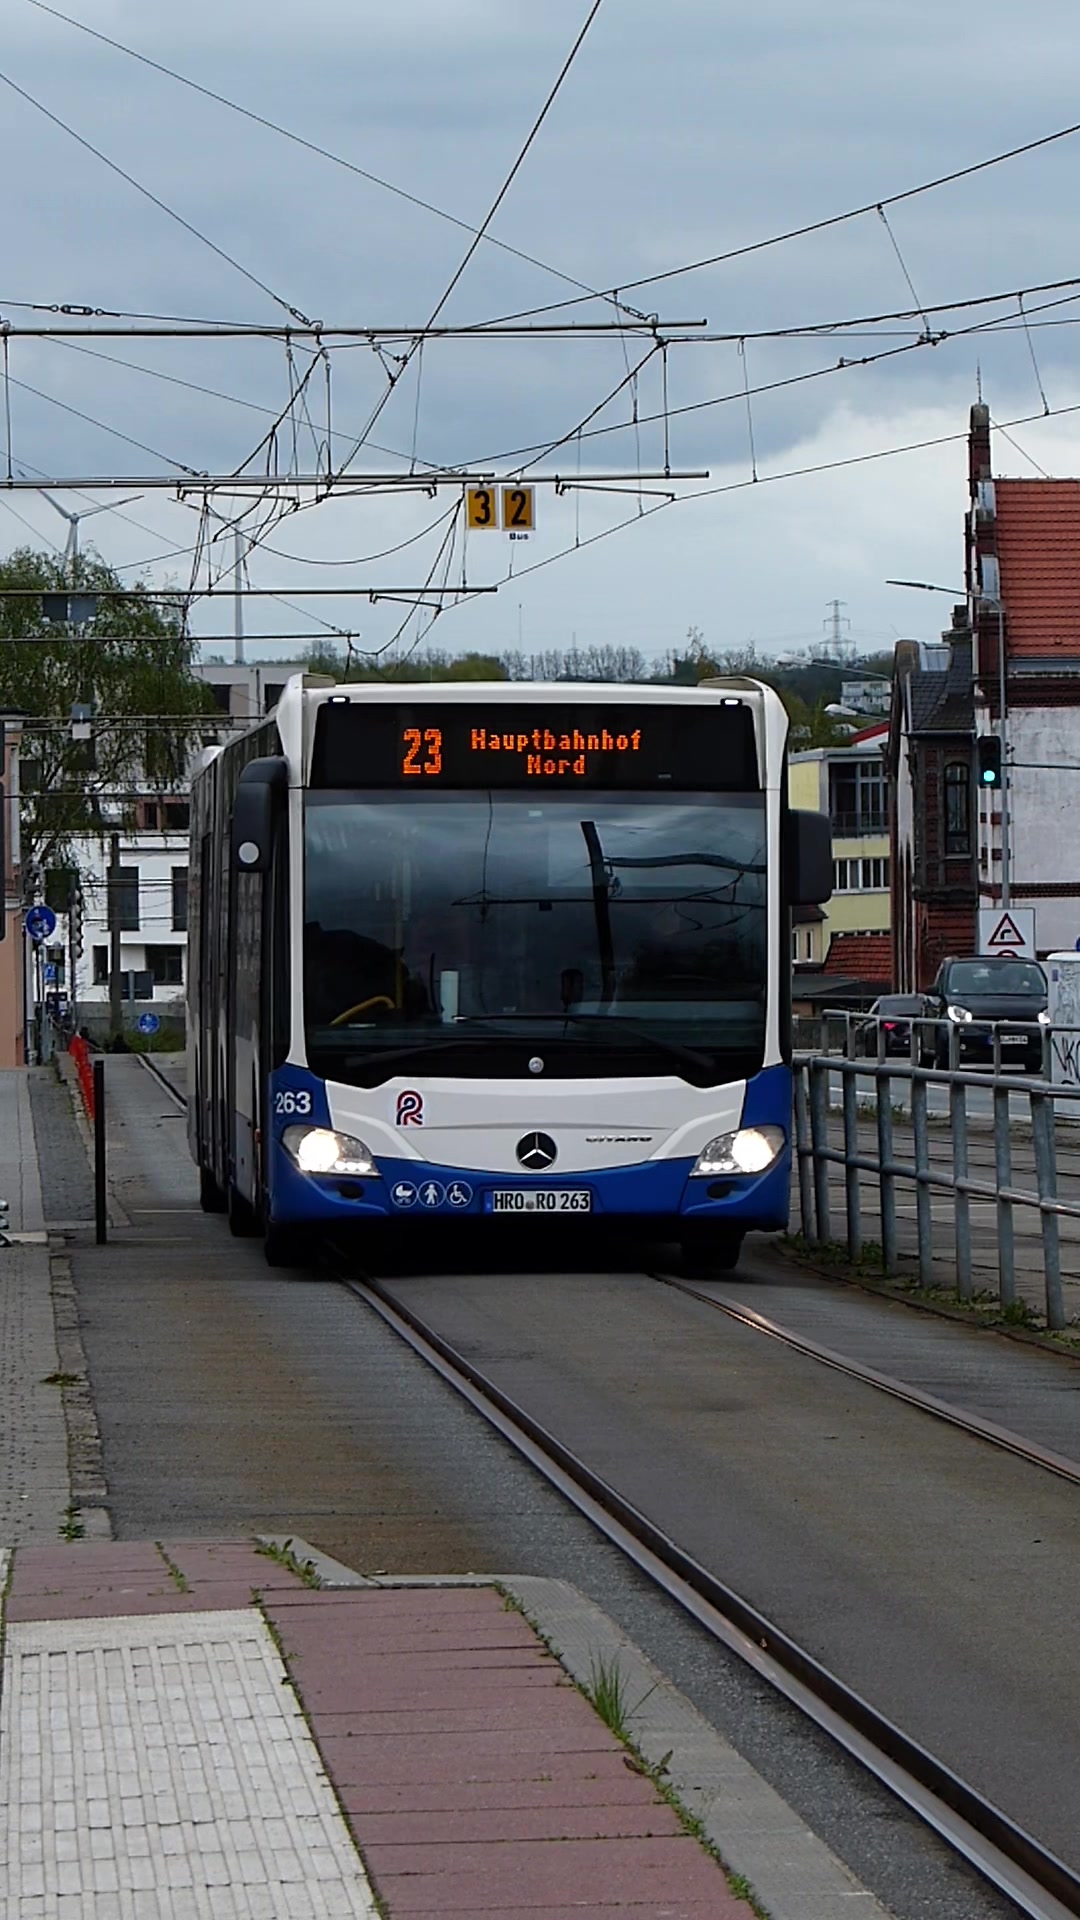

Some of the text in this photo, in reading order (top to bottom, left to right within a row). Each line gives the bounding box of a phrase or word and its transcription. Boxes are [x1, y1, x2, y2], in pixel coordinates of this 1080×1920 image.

[474, 490, 527, 525] 3 2
[509, 532, 529, 540] Bus
[402, 728, 642, 774] 23 Hauptbahnhof
[526, 754, 586, 774] Nord
[275, 1091, 312, 1114] 263
[494, 1192, 589, 1210] HRO RO 263
